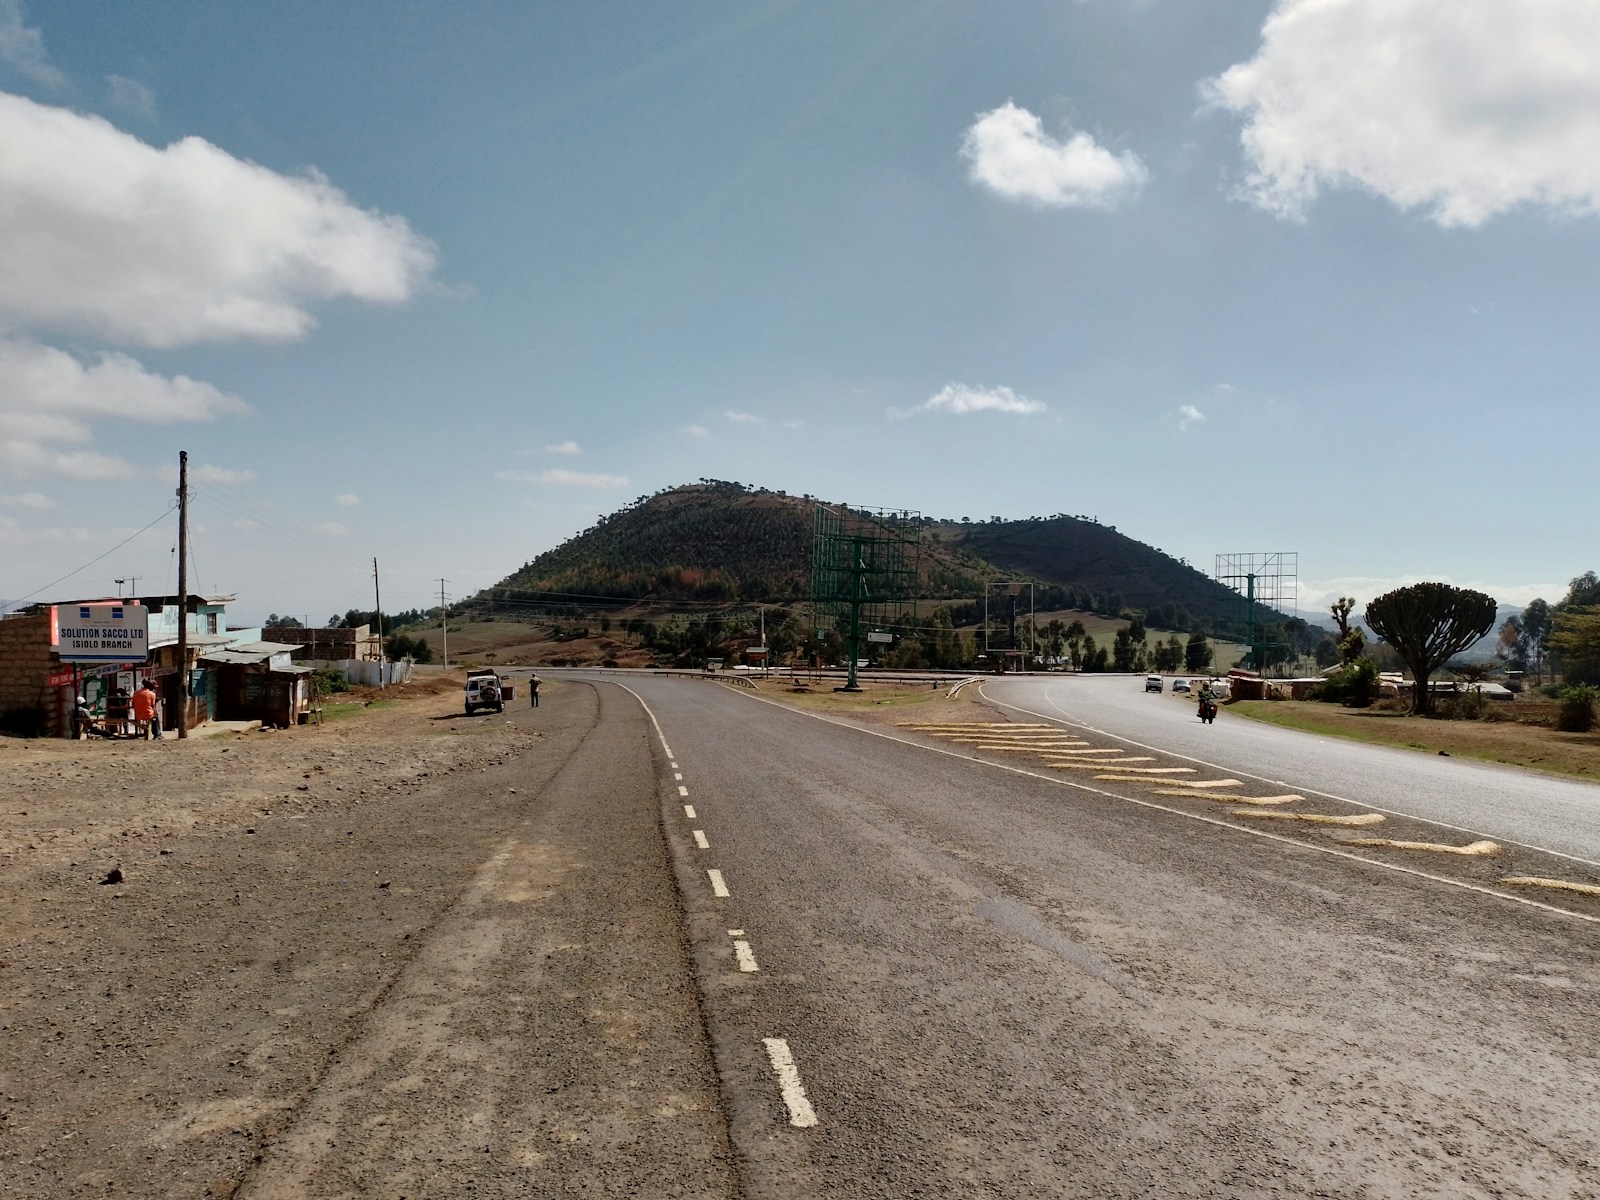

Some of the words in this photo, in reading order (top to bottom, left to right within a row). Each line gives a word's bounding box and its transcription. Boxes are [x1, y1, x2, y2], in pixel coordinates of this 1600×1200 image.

[61, 628, 100, 639] SOLUTION
[102, 628, 129, 639] SACCO
[130, 629, 144, 639] LTD
[72, 640, 99, 649] ISIOLO
[101, 640, 133, 649] BRANCH
